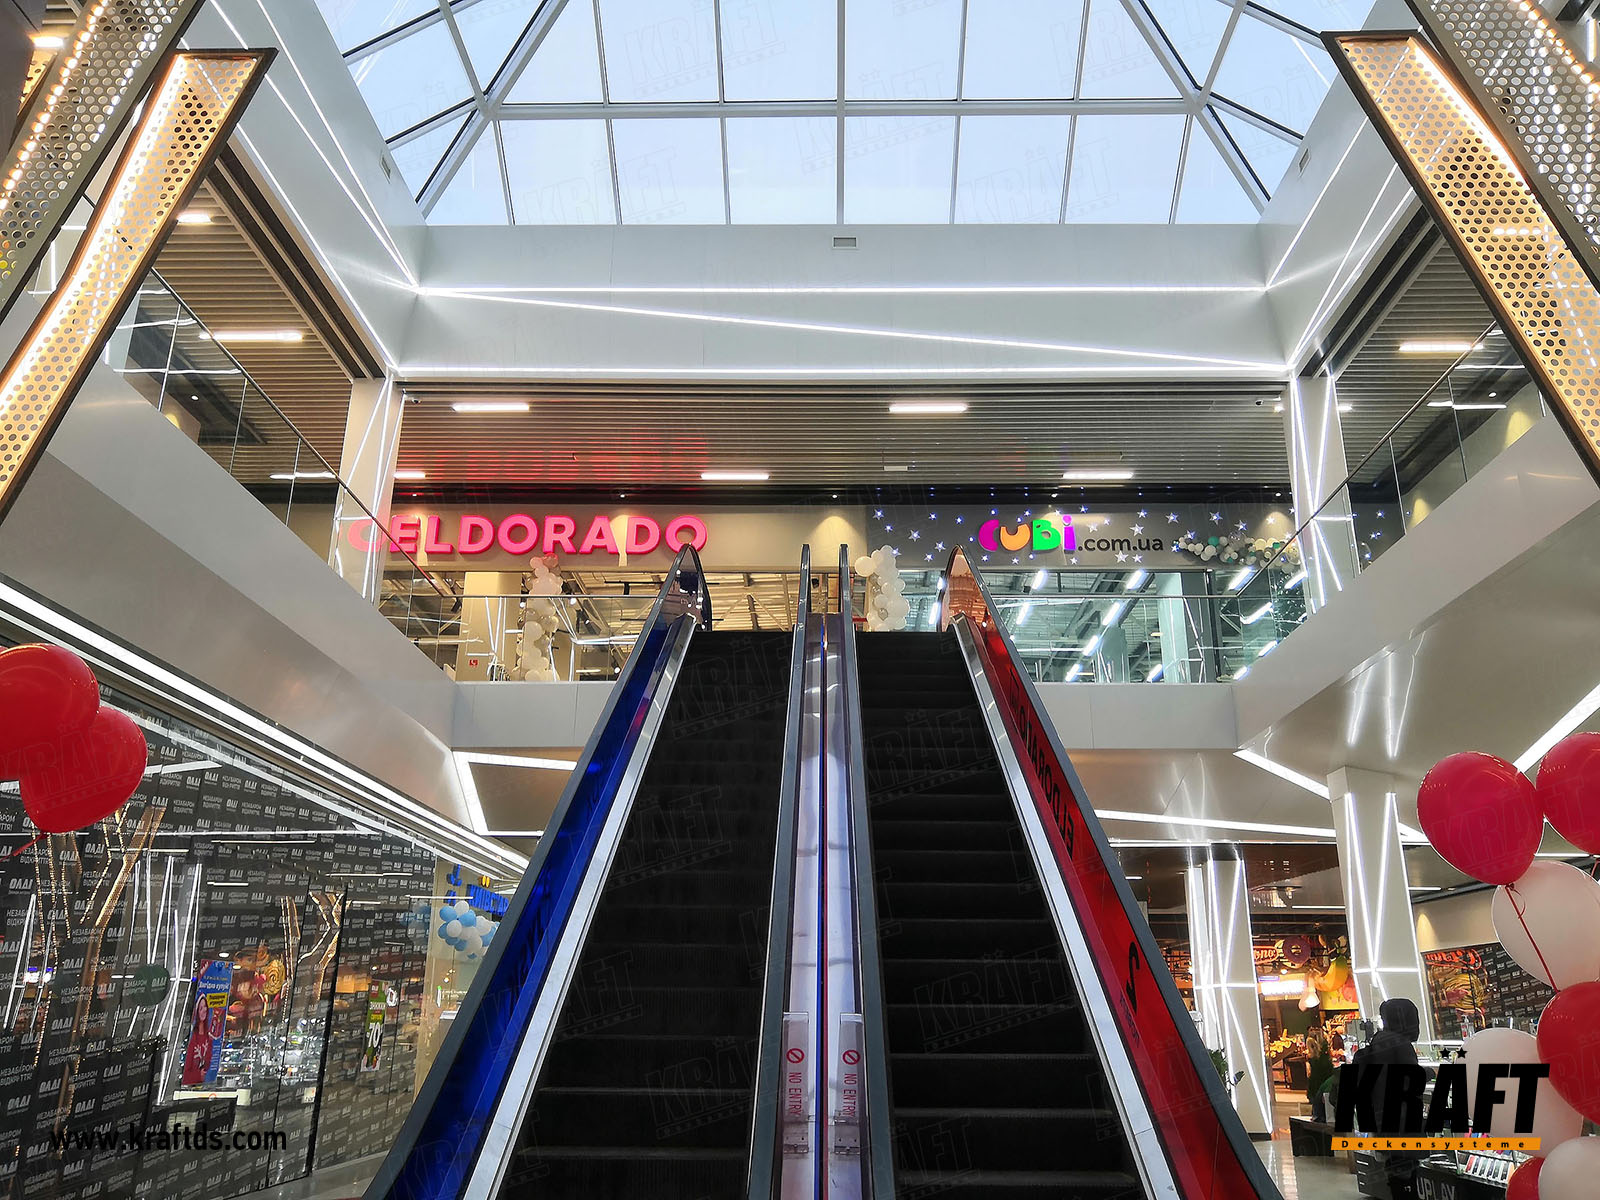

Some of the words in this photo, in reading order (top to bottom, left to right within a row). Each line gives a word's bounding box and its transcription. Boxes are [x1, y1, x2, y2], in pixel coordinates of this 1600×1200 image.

[389, 514, 707, 554] ELDORADO
[85, 843, 104, 853] ОЛДІ
[9, 878, 33, 889] ОЛДІ
[108, 928, 126, 938] ОЛДІ
[64, 958, 84, 969] ОЛДІ
[52, 1017, 73, 1029] ОЛДІ
[21, 1032, 40, 1044] ОЛД
[788, 1072, 802, 1084] NO
[844, 1073, 857, 1085] NO
[39, 1078, 61, 1093] ОЛДІ
[7, 1095, 31, 1110] ОЛДІ
[75, 1098, 95, 1114] ОЛДІ
[788, 1087, 803, 1116] ENTRY
[843, 1089, 857, 1118] ENTRY
[26, 1141, 49, 1159] ОЛДІ
[63, 1160, 84, 1176] ОЛДІ
